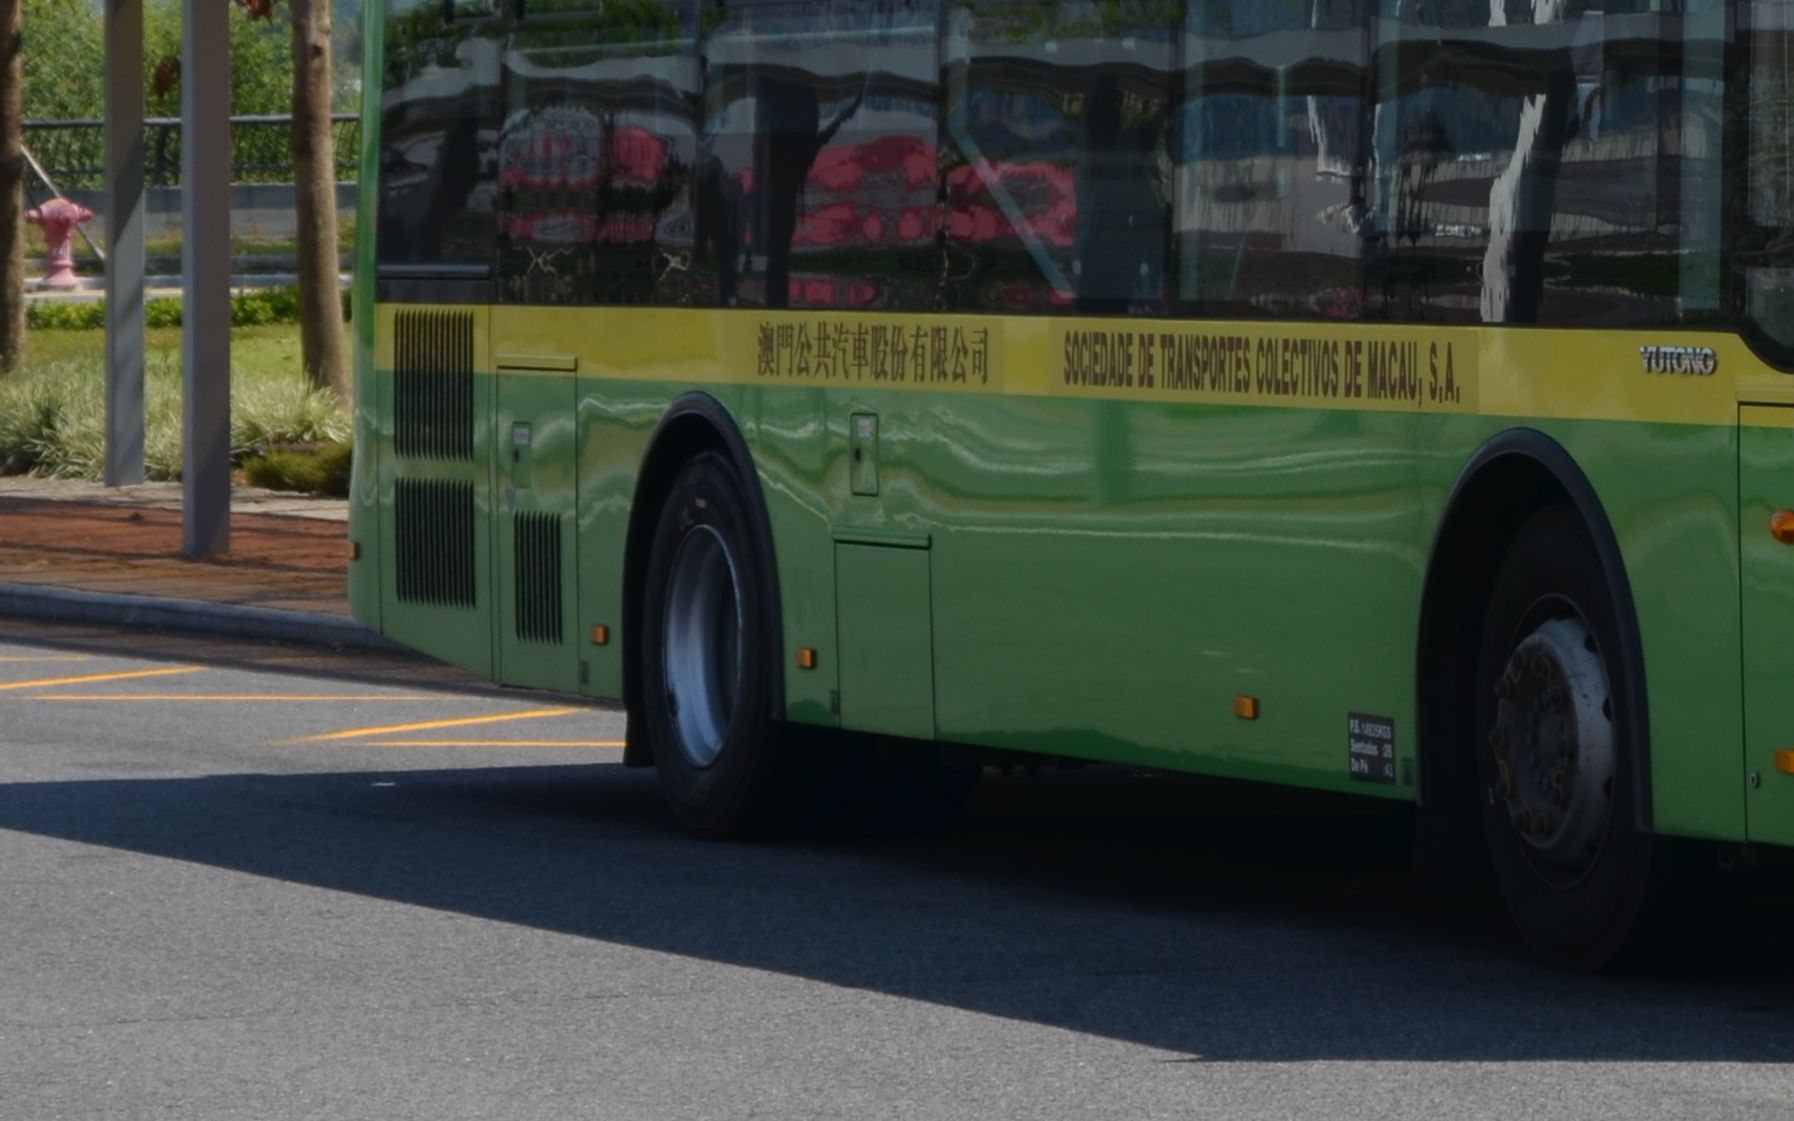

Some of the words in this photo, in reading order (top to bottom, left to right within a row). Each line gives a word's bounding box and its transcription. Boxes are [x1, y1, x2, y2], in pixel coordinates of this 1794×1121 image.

[757, 320, 988, 385] 澳門公共汽車股份有限公司
[1064, 331, 1133, 387] SOCIEDADE
[1138, 333, 1155, 388] DE
[1160, 334, 1251, 393] TRANSPORTES
[1256, 337, 1339, 398] COLECTIVOS
[1344, 340, 1363, 398] DE
[1367, 341, 1423, 408] MACAU,
[1429, 341, 1460, 404] S.A.
[1639, 345, 1717, 375] YUTONG
